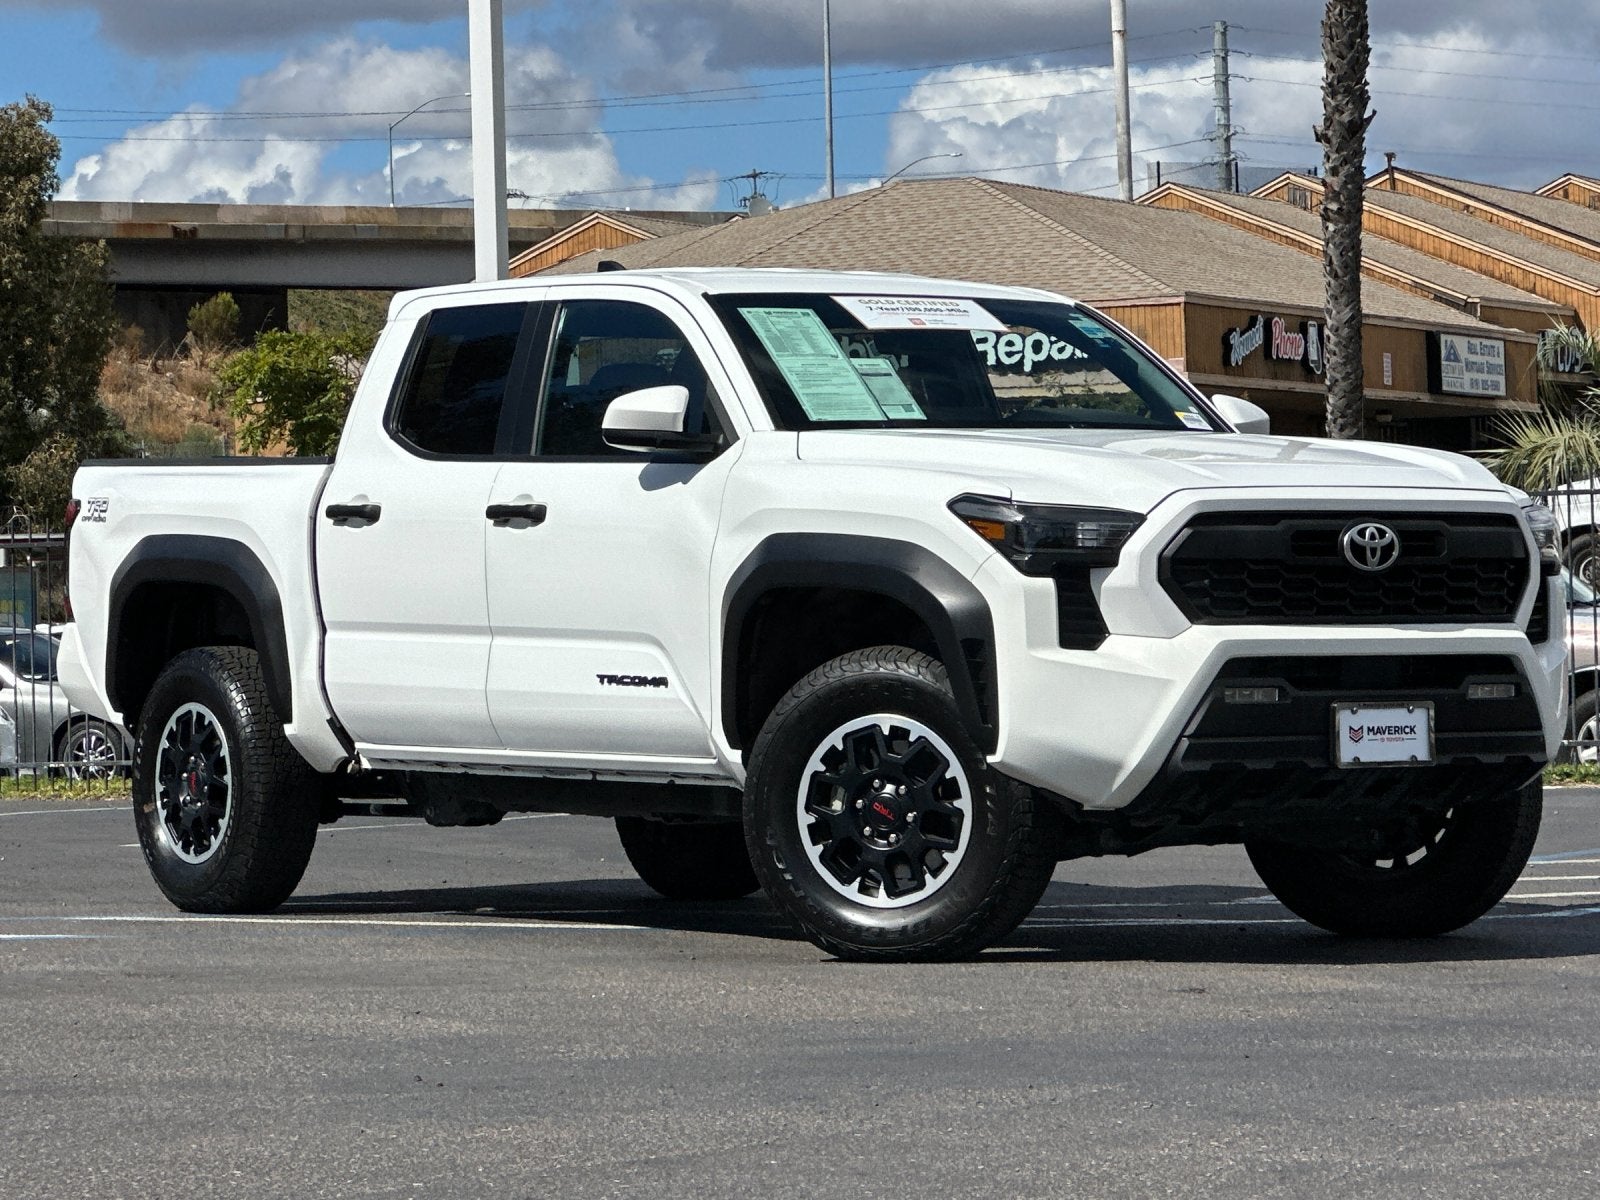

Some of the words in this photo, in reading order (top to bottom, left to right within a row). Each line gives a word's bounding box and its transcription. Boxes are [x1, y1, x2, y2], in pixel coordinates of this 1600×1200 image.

[858, 299, 894, 307] GOLD
[897, 299, 960, 307] CERTIFIED
[1271, 316, 1305, 360] Phone
[596, 674, 669, 688] TACOMA
[1367, 725, 1417, 736] MAVERICK
